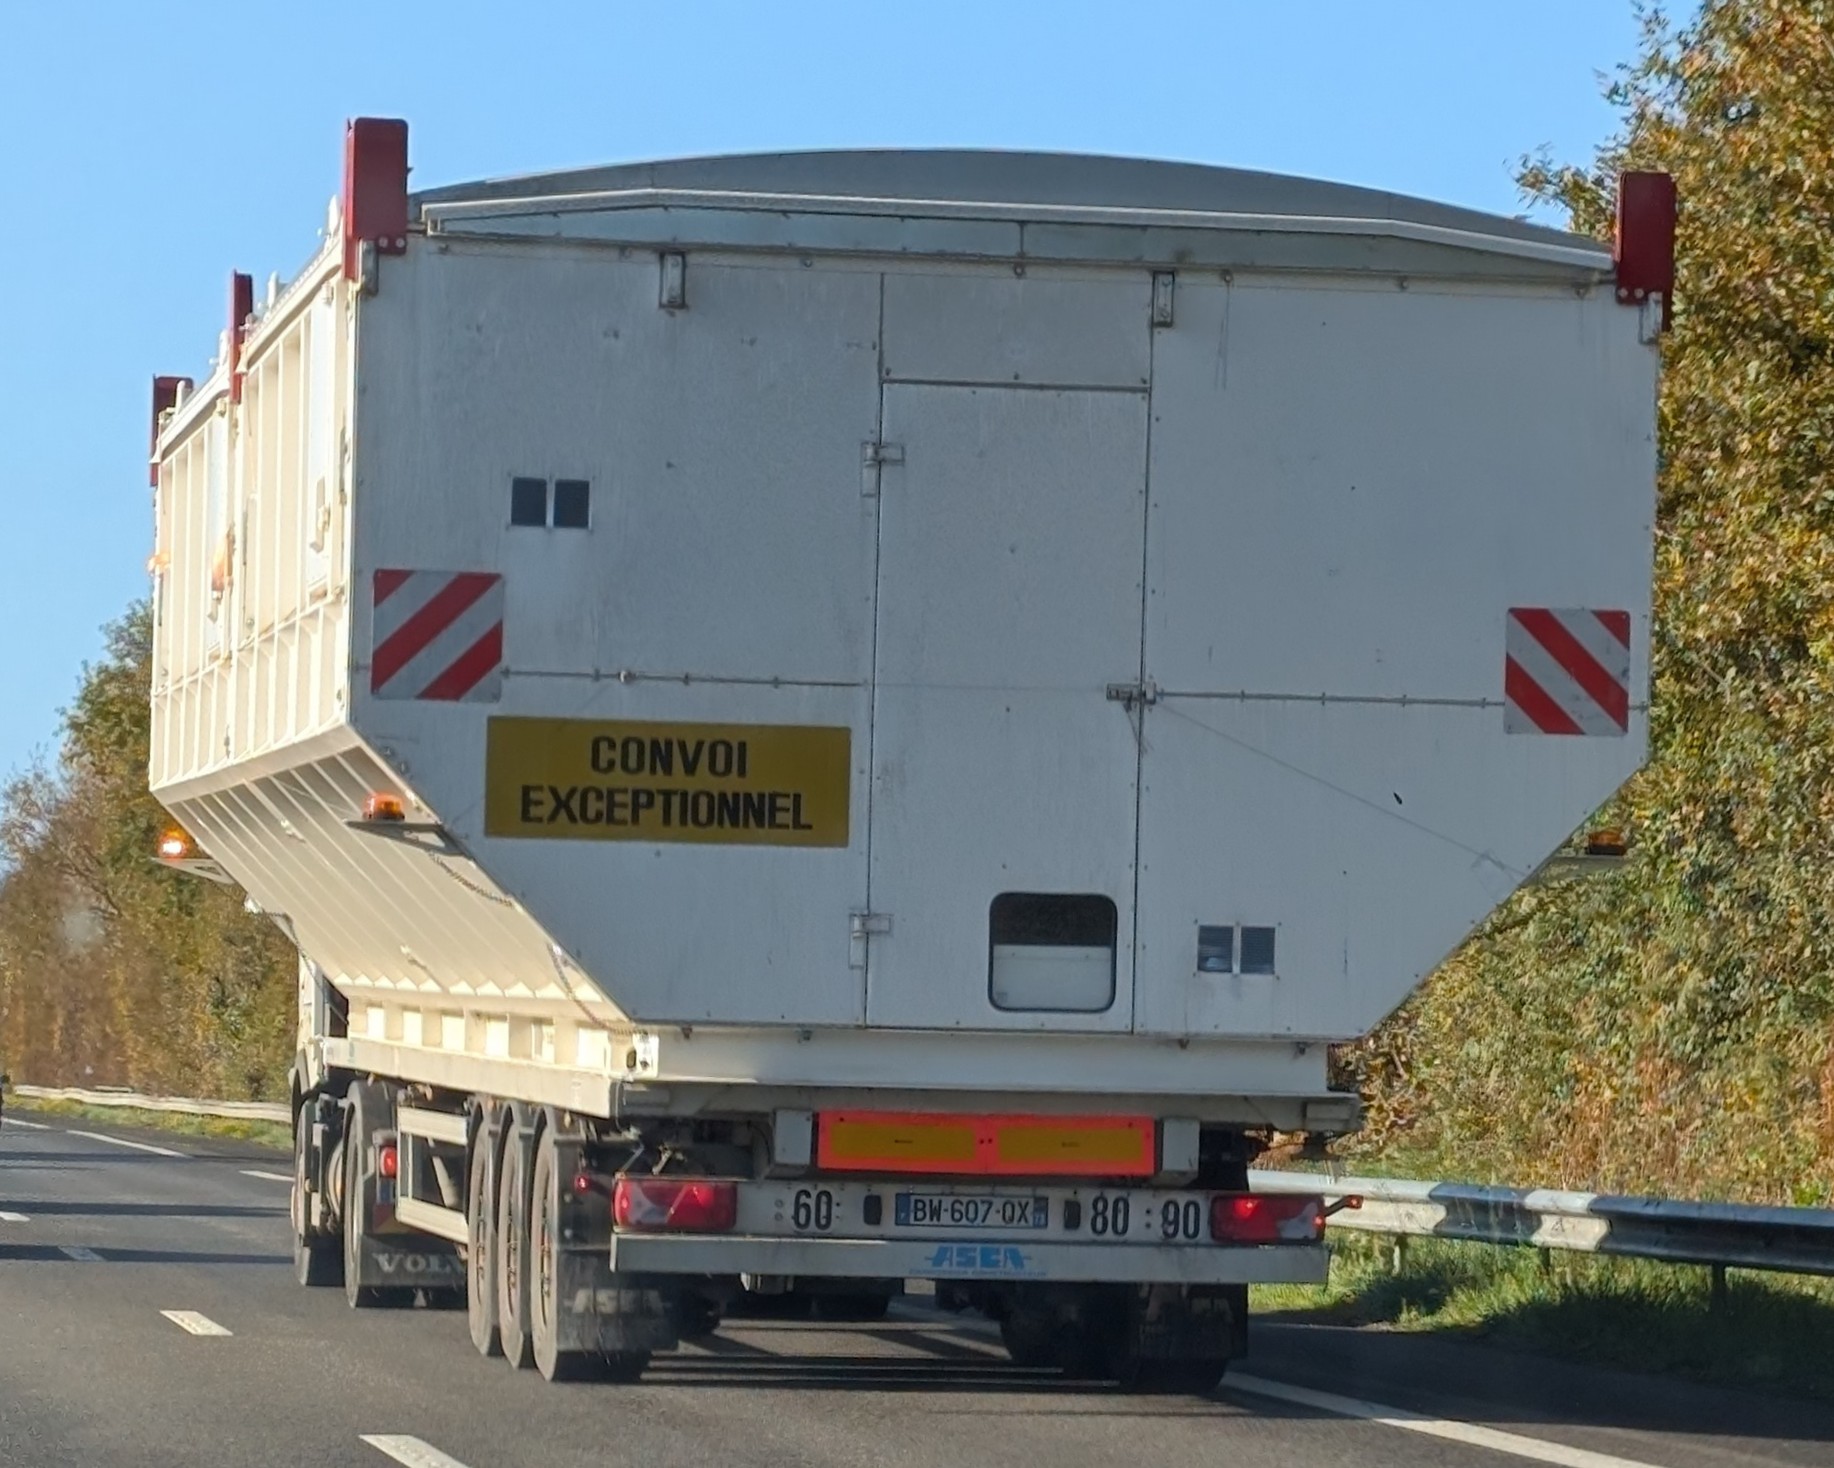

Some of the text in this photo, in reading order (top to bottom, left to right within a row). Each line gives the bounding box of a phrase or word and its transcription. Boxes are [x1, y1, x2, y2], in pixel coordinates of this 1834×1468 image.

[590, 735, 747, 778] CONVOI
[520, 784, 813, 831] EXCEPTIONNEL
[793, 1189, 833, 1231] 60
[912, 1198, 1030, 1225] BW-607-QX
[1090, 1196, 1130, 1236] 80
[1161, 1199, 1201, 1240] 90
